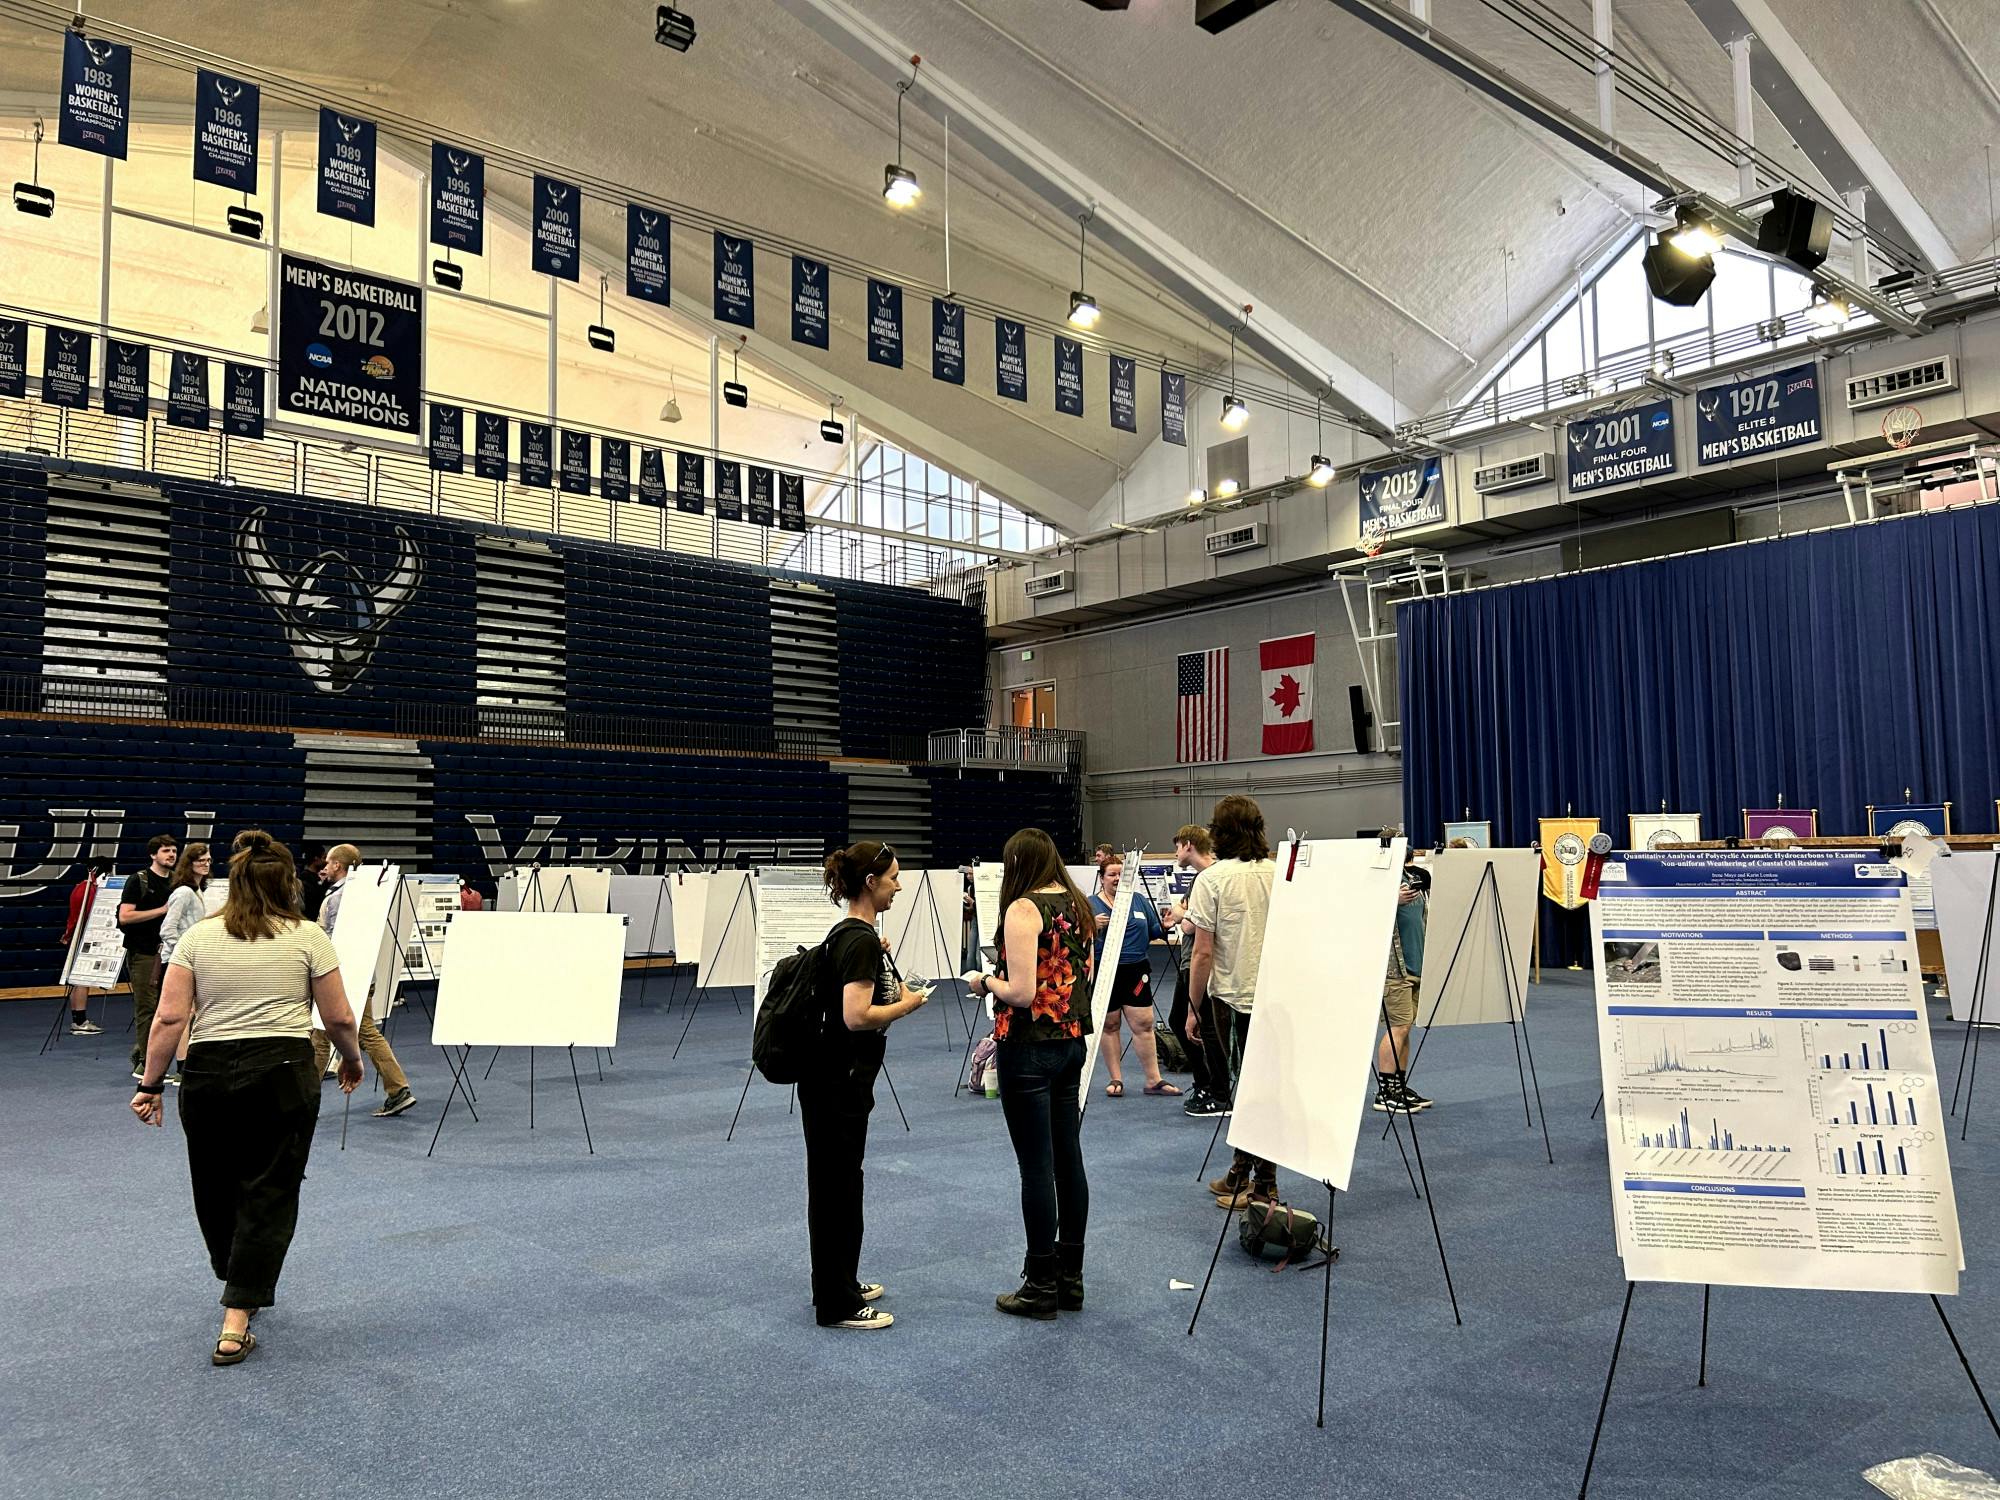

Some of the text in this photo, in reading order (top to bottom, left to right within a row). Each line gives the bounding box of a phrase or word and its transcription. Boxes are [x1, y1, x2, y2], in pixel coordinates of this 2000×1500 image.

[83, 67, 112, 88] 1983
[75, 84, 118, 105] WOMEN'S
[69, 95, 123, 118] BASKETBALL
[75, 116, 115, 130] CHAMPIONS
[88, 112, 116, 124] DISTRICT
[214, 107, 241, 127] 1986
[208, 122, 247, 141] WOMEN'S
[202, 132, 252, 154] BASKETBALL
[208, 152, 245, 166] CHAMPIONS
[336, 143, 360, 162] 1989
[330, 158, 366, 177] WOMEN'S
[324, 168, 370, 189] BASKETBALL
[447, 177, 470, 194] 1996
[330, 187, 364, 200] CHAMPIONS
[441, 191, 474, 208] WOMEN'S
[437, 200, 479, 220] BASKETBALL
[546, 208, 568, 224] 2000
[542, 220, 572, 237] WOMEN'S
[538, 230, 576, 248] BASKETBALL
[638, 234, 659, 250] 2000
[634, 248, 663, 264] WOMEN'S
[631, 257, 666, 274] BASKETBALL
[723, 260, 743, 275] 2002
[721, 272, 747, 286] WOMEN'S
[287, 265, 416, 312] MEN'S BASKETBALL
[718, 281, 750, 297] BASKETBALL
[802, 283, 820, 298] 2006
[799, 296, 823, 310] WOMEN'S
[796, 303, 825, 319] BASKETBALL
[878, 306, 892, 319] 2011
[319, 300, 385, 348] 2012
[874, 318, 896, 330] WOMEN'S
[942, 325, 956, 337] 2013
[871, 325, 900, 340] BASKETBALL
[0, 343, 14, 353] 972
[938, 336, 959, 348] WOMEN'S
[0, 354, 14, 362] EN'S
[58, 352, 77, 363] 1979
[936, 344, 962, 358] BASKETBALL
[308, 353, 332, 364] NCAA
[1002, 354, 1022, 366] WOMEN'S
[0, 362, 22, 371] ETBALL
[58, 363, 77, 373] MEN'S
[117, 364, 137, 375] 1988
[1000, 360, 1024, 374] BASKETBALL
[48, 369, 85, 382] BASKETBALL
[118, 375, 136, 384] MEN'S
[181, 374, 200, 385] 1994
[1060, 371, 1078, 382] WOMEN'S
[109, 381, 144, 393] BASKETBALL
[182, 386, 199, 395] MEN'S
[235, 386, 253, 397] 2001
[1058, 378, 1080, 391] BASKETBALL
[1787, 378, 1813, 396] NAIA
[173, 393, 206, 404] BASKETBALL
[300, 376, 402, 409] NATIONAL
[1115, 388, 1132, 400] WOMEN'S
[1729, 380, 1780, 418] 1972
[236, 397, 252, 406] MEN'S
[1113, 394, 1134, 407] BASKETBALL
[228, 403, 260, 414] BASKETBALL
[290, 392, 409, 427] CHAMPIONS
[1166, 403, 1182, 414] WOMEN'S
[440, 425, 454, 434] 2001
[1652, 419, 1669, 429] NCAA
[1738, 417, 1776, 432] ELITE 8
[484, 433, 499, 443] 2002
[1594, 414, 1640, 450] 2001
[433, 440, 460, 450] BASKETBALL
[1702, 420, 1818, 460] MEN'S BASKETBALL
[478, 448, 504, 459] BASKETBALL
[1593, 446, 1647, 464] FINAL FOUR
[523, 457, 548, 467] BASKETBALL
[563, 464, 588, 474] BASKETBALL
[603, 471, 628, 481] BASKETBALL
[1572, 454, 1672, 487] MEN'S BASKETBALL
[1382, 470, 1417, 500] 2013
[1379, 498, 1423, 513] FINAL FOUR
[1389, 504, 1442, 528] BASKETBALL
